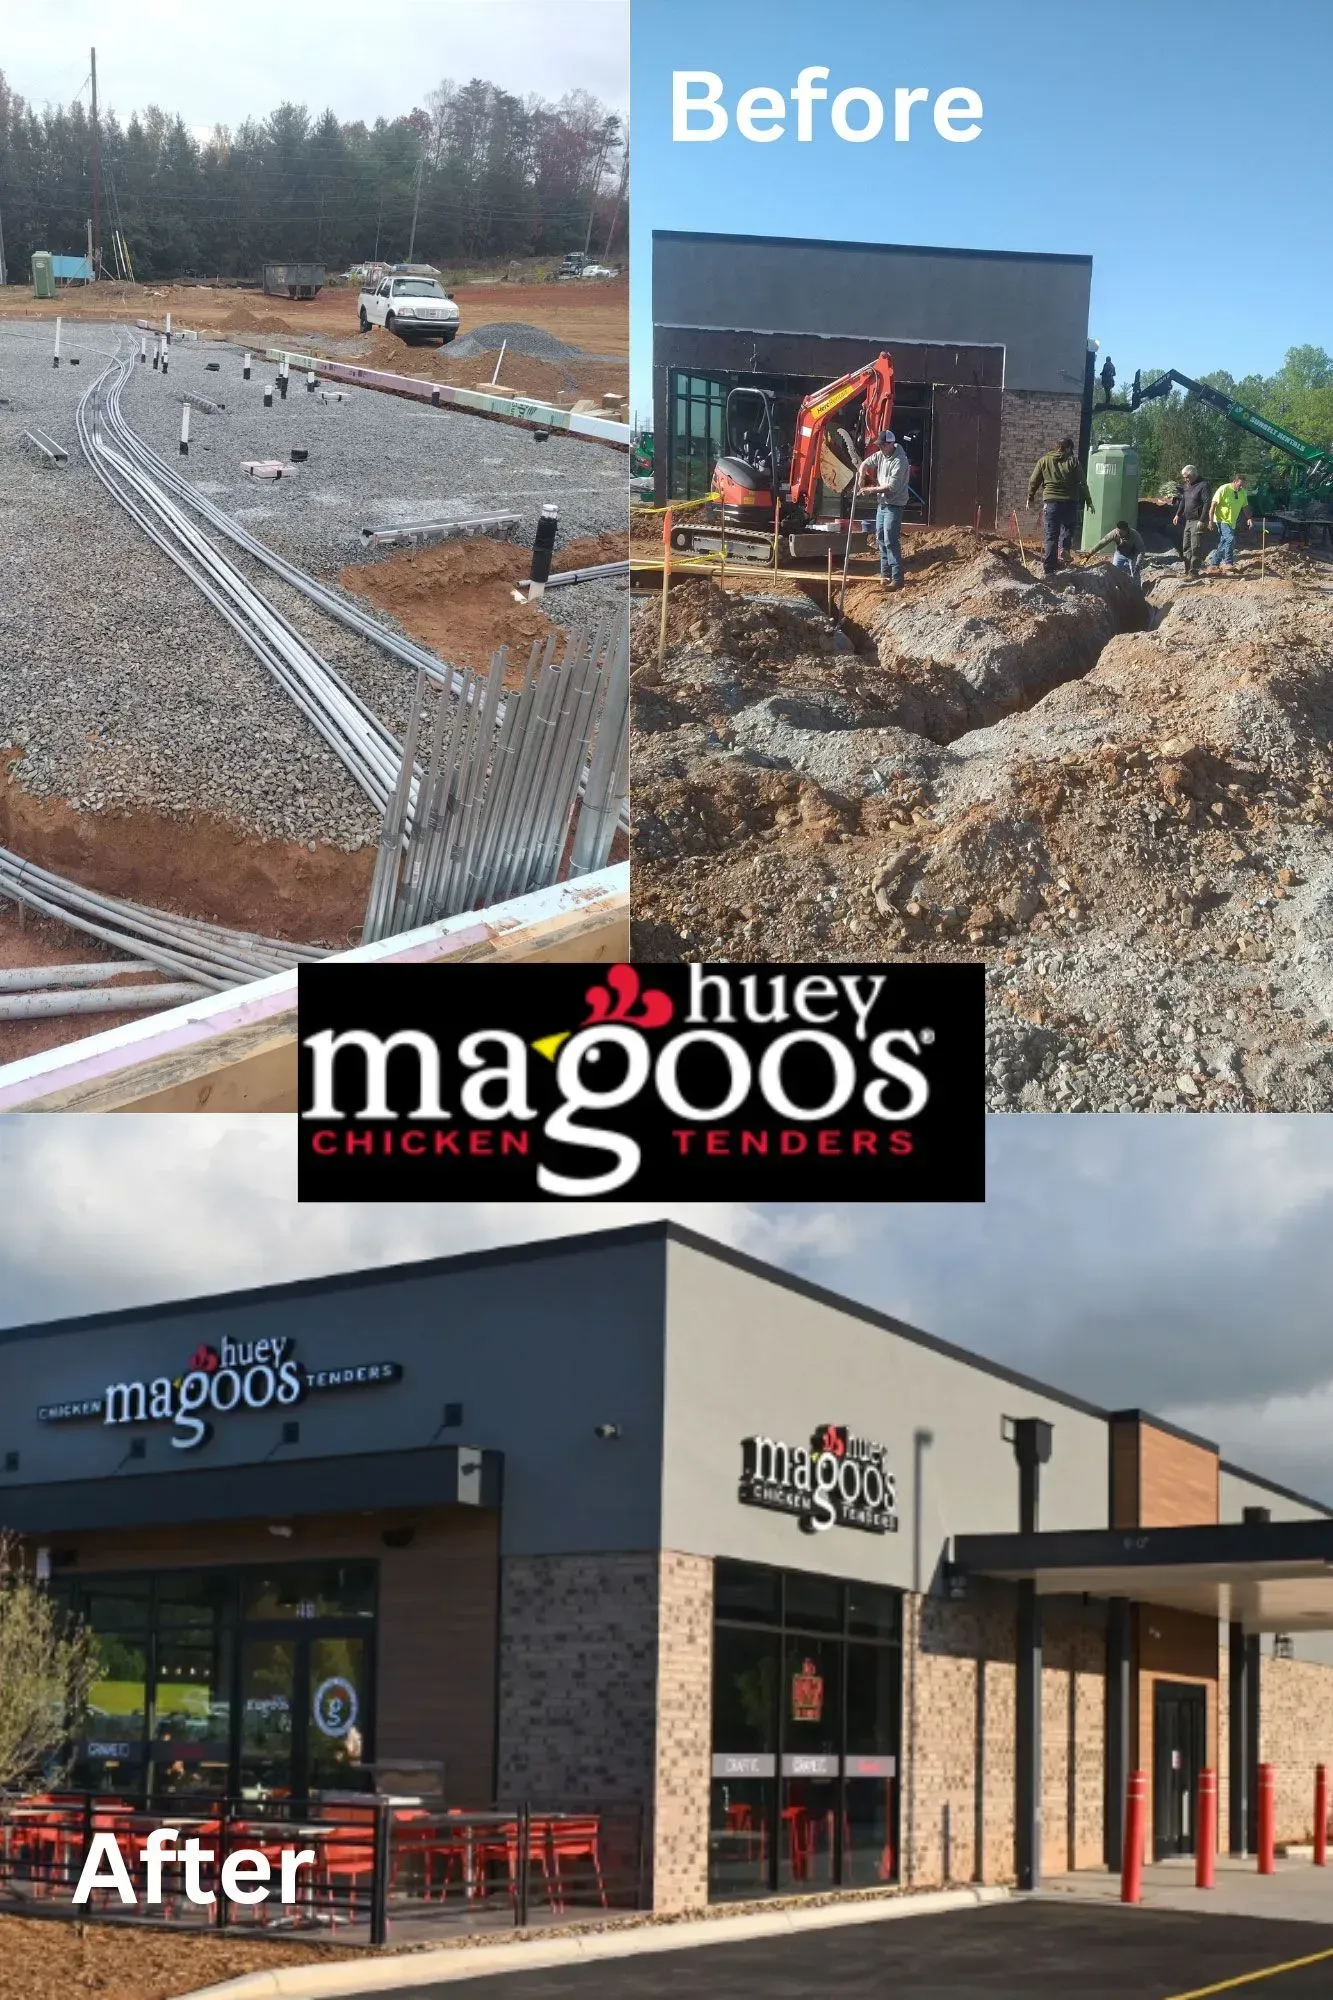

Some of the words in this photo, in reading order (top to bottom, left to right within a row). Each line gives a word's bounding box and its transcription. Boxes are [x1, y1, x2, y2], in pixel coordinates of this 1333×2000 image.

[1249, 416, 1279, 436] SUNBELT
[1276, 431, 1306, 452] RENTALS
[219, 1334, 288, 1368] huey
[38, 1400, 101, 1421] CHICKEN
[306, 1363, 393, 1388] TENDERS
[752, 1485, 812, 1511] CHICKEN
